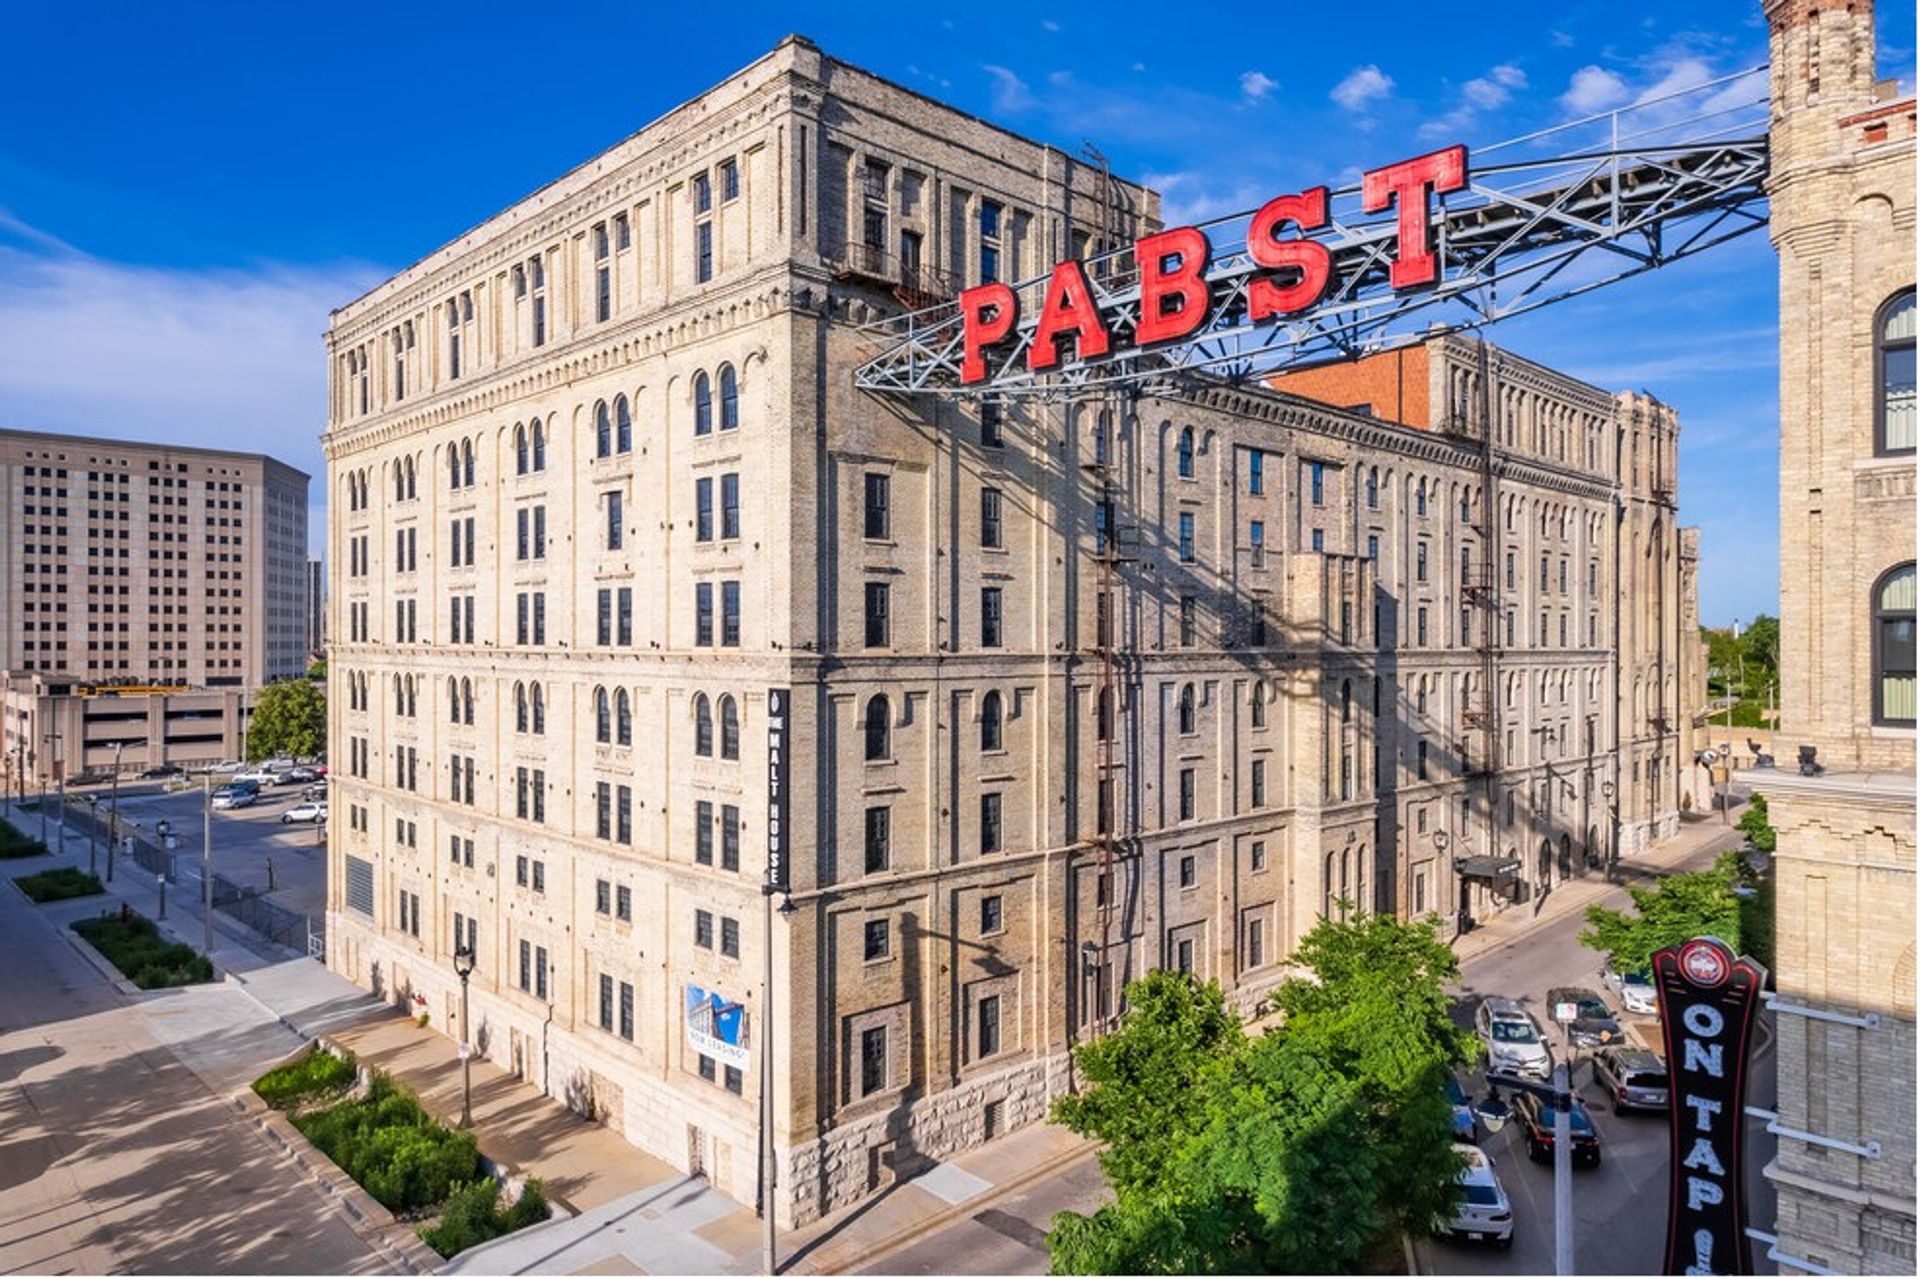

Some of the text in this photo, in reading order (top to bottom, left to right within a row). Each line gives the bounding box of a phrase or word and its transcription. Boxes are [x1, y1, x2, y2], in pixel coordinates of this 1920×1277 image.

[959, 144, 1468, 385] PABST
[769, 733, 780, 797] MALT
[770, 804, 780, 884] HOUSE
[1682, 1003, 1725, 1211] ON TAP
